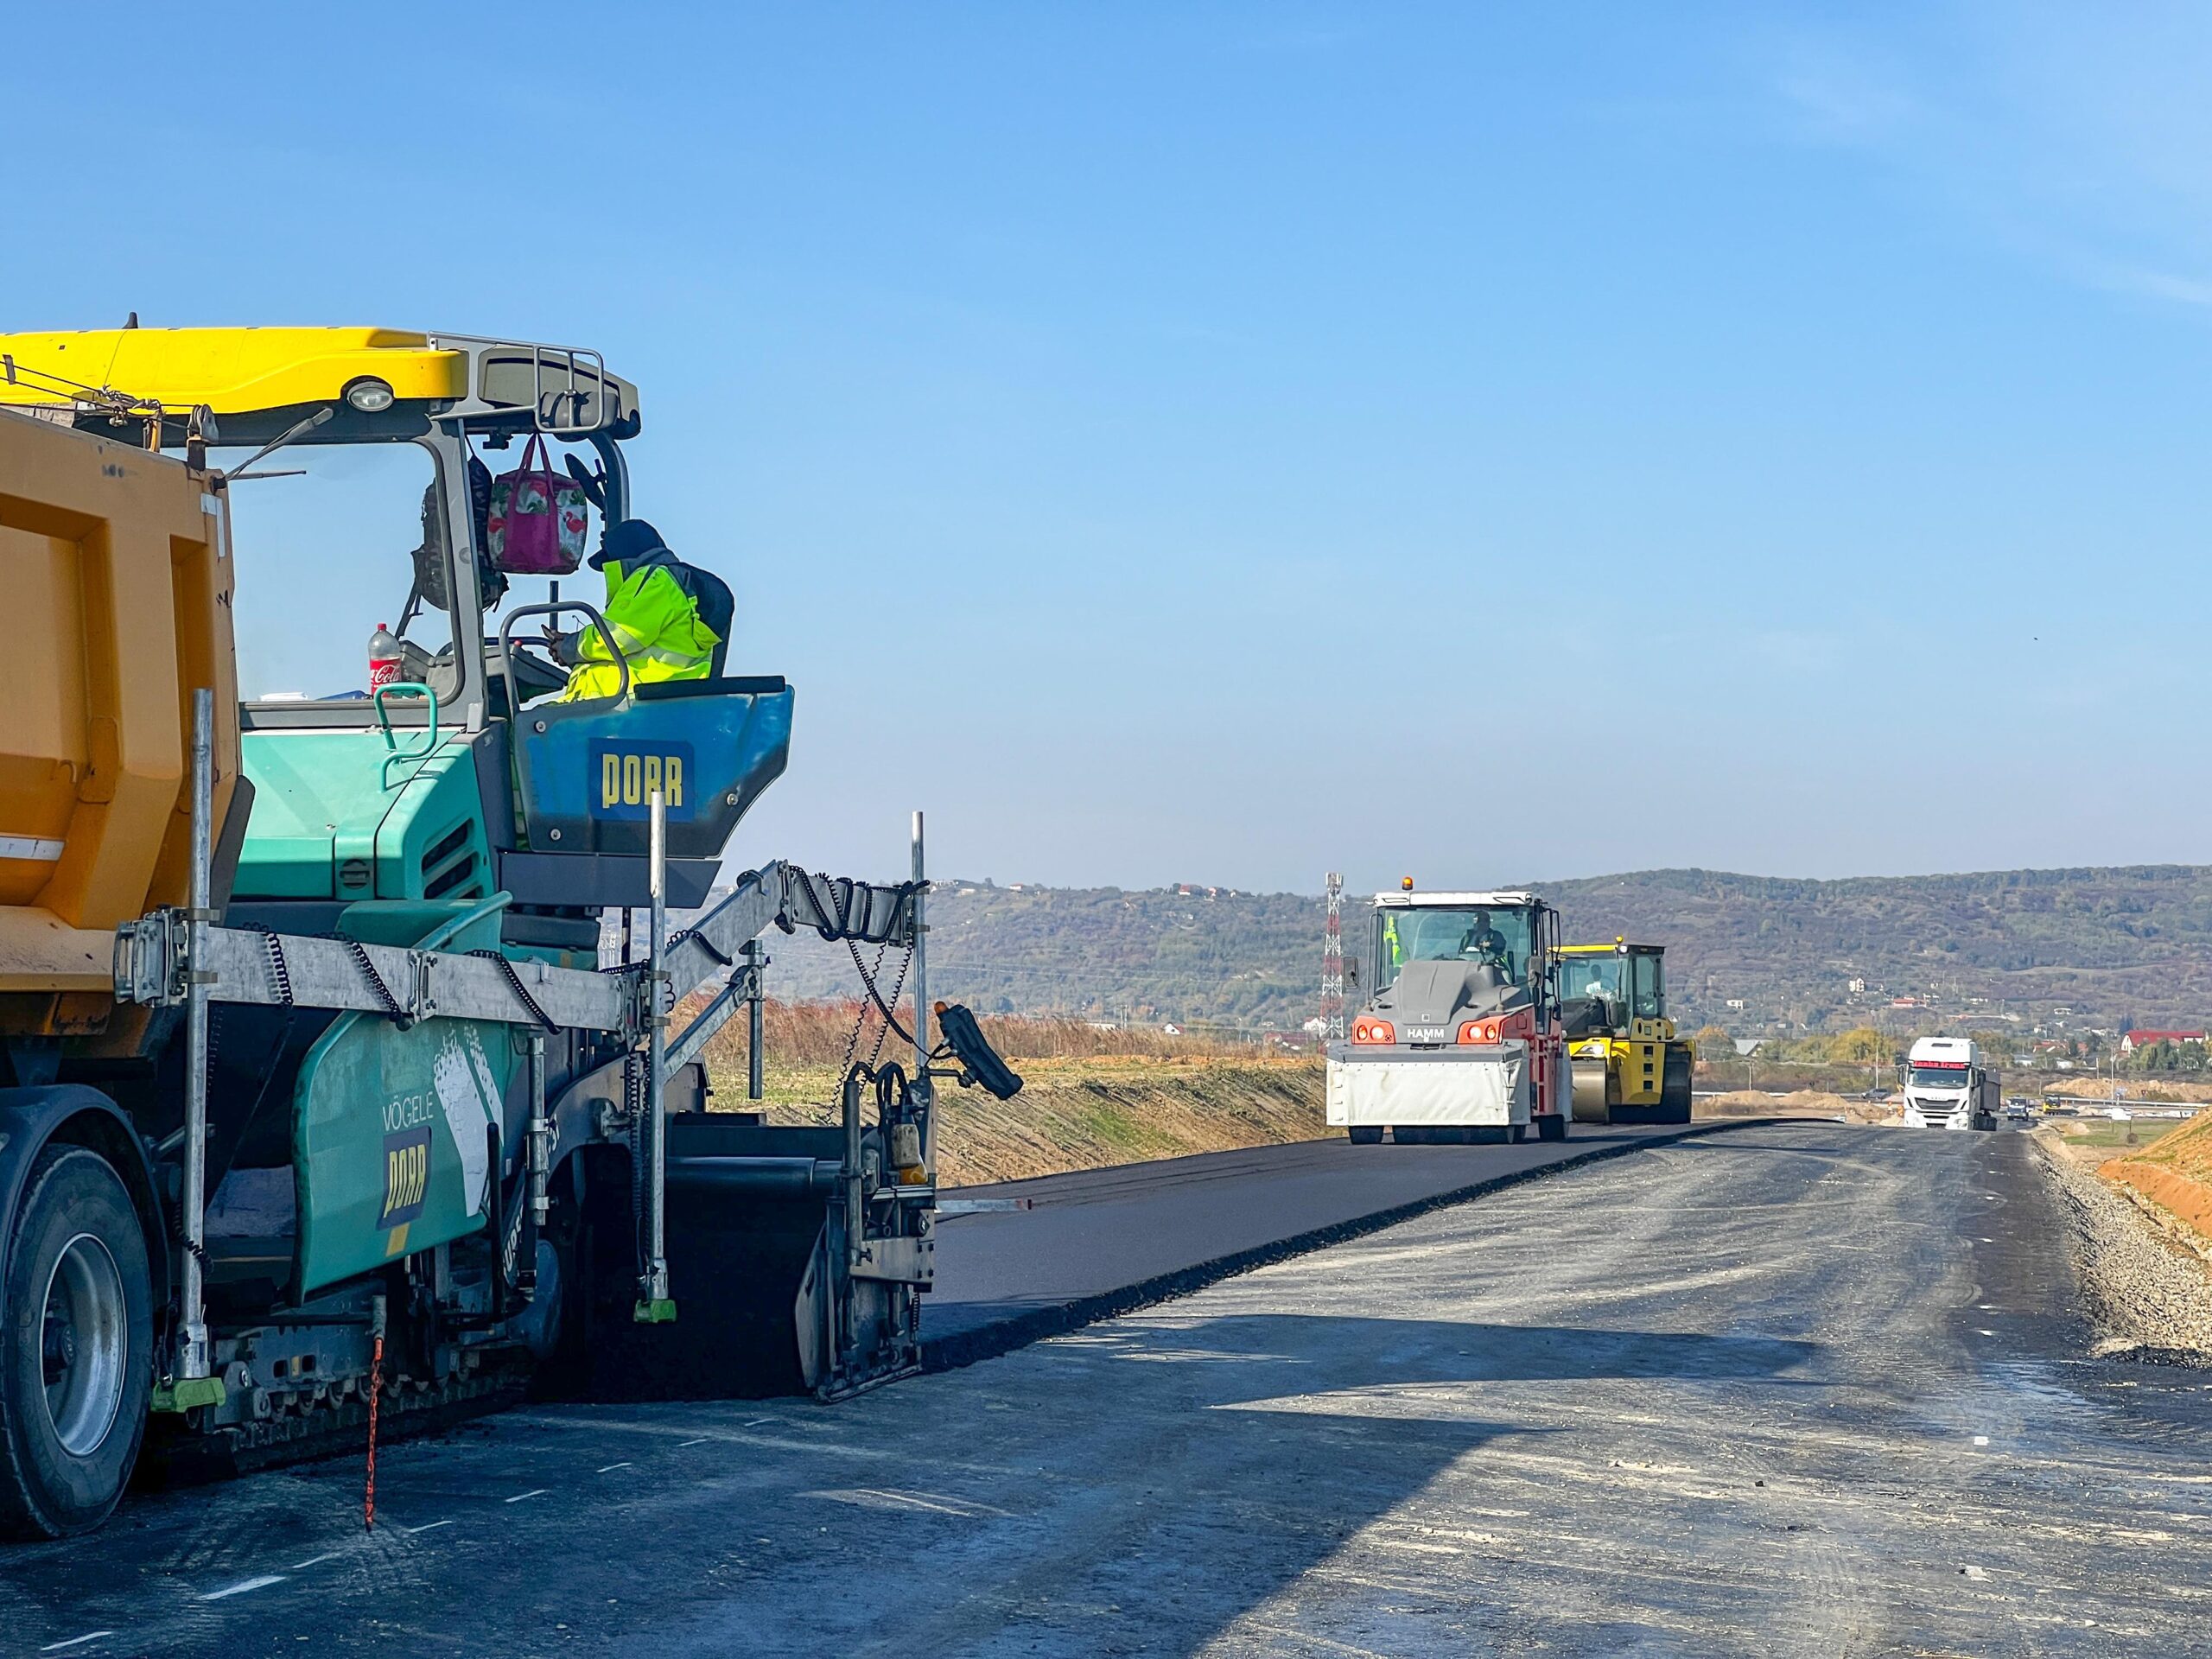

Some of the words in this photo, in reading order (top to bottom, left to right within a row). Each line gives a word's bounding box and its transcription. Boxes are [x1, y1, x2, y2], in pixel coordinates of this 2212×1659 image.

[602, 753, 682, 809] PORR
[1407, 1028, 1445, 1039] HAMM
[382, 1091, 434, 1131] VÖGELE
[383, 1143, 426, 1218] PORR
